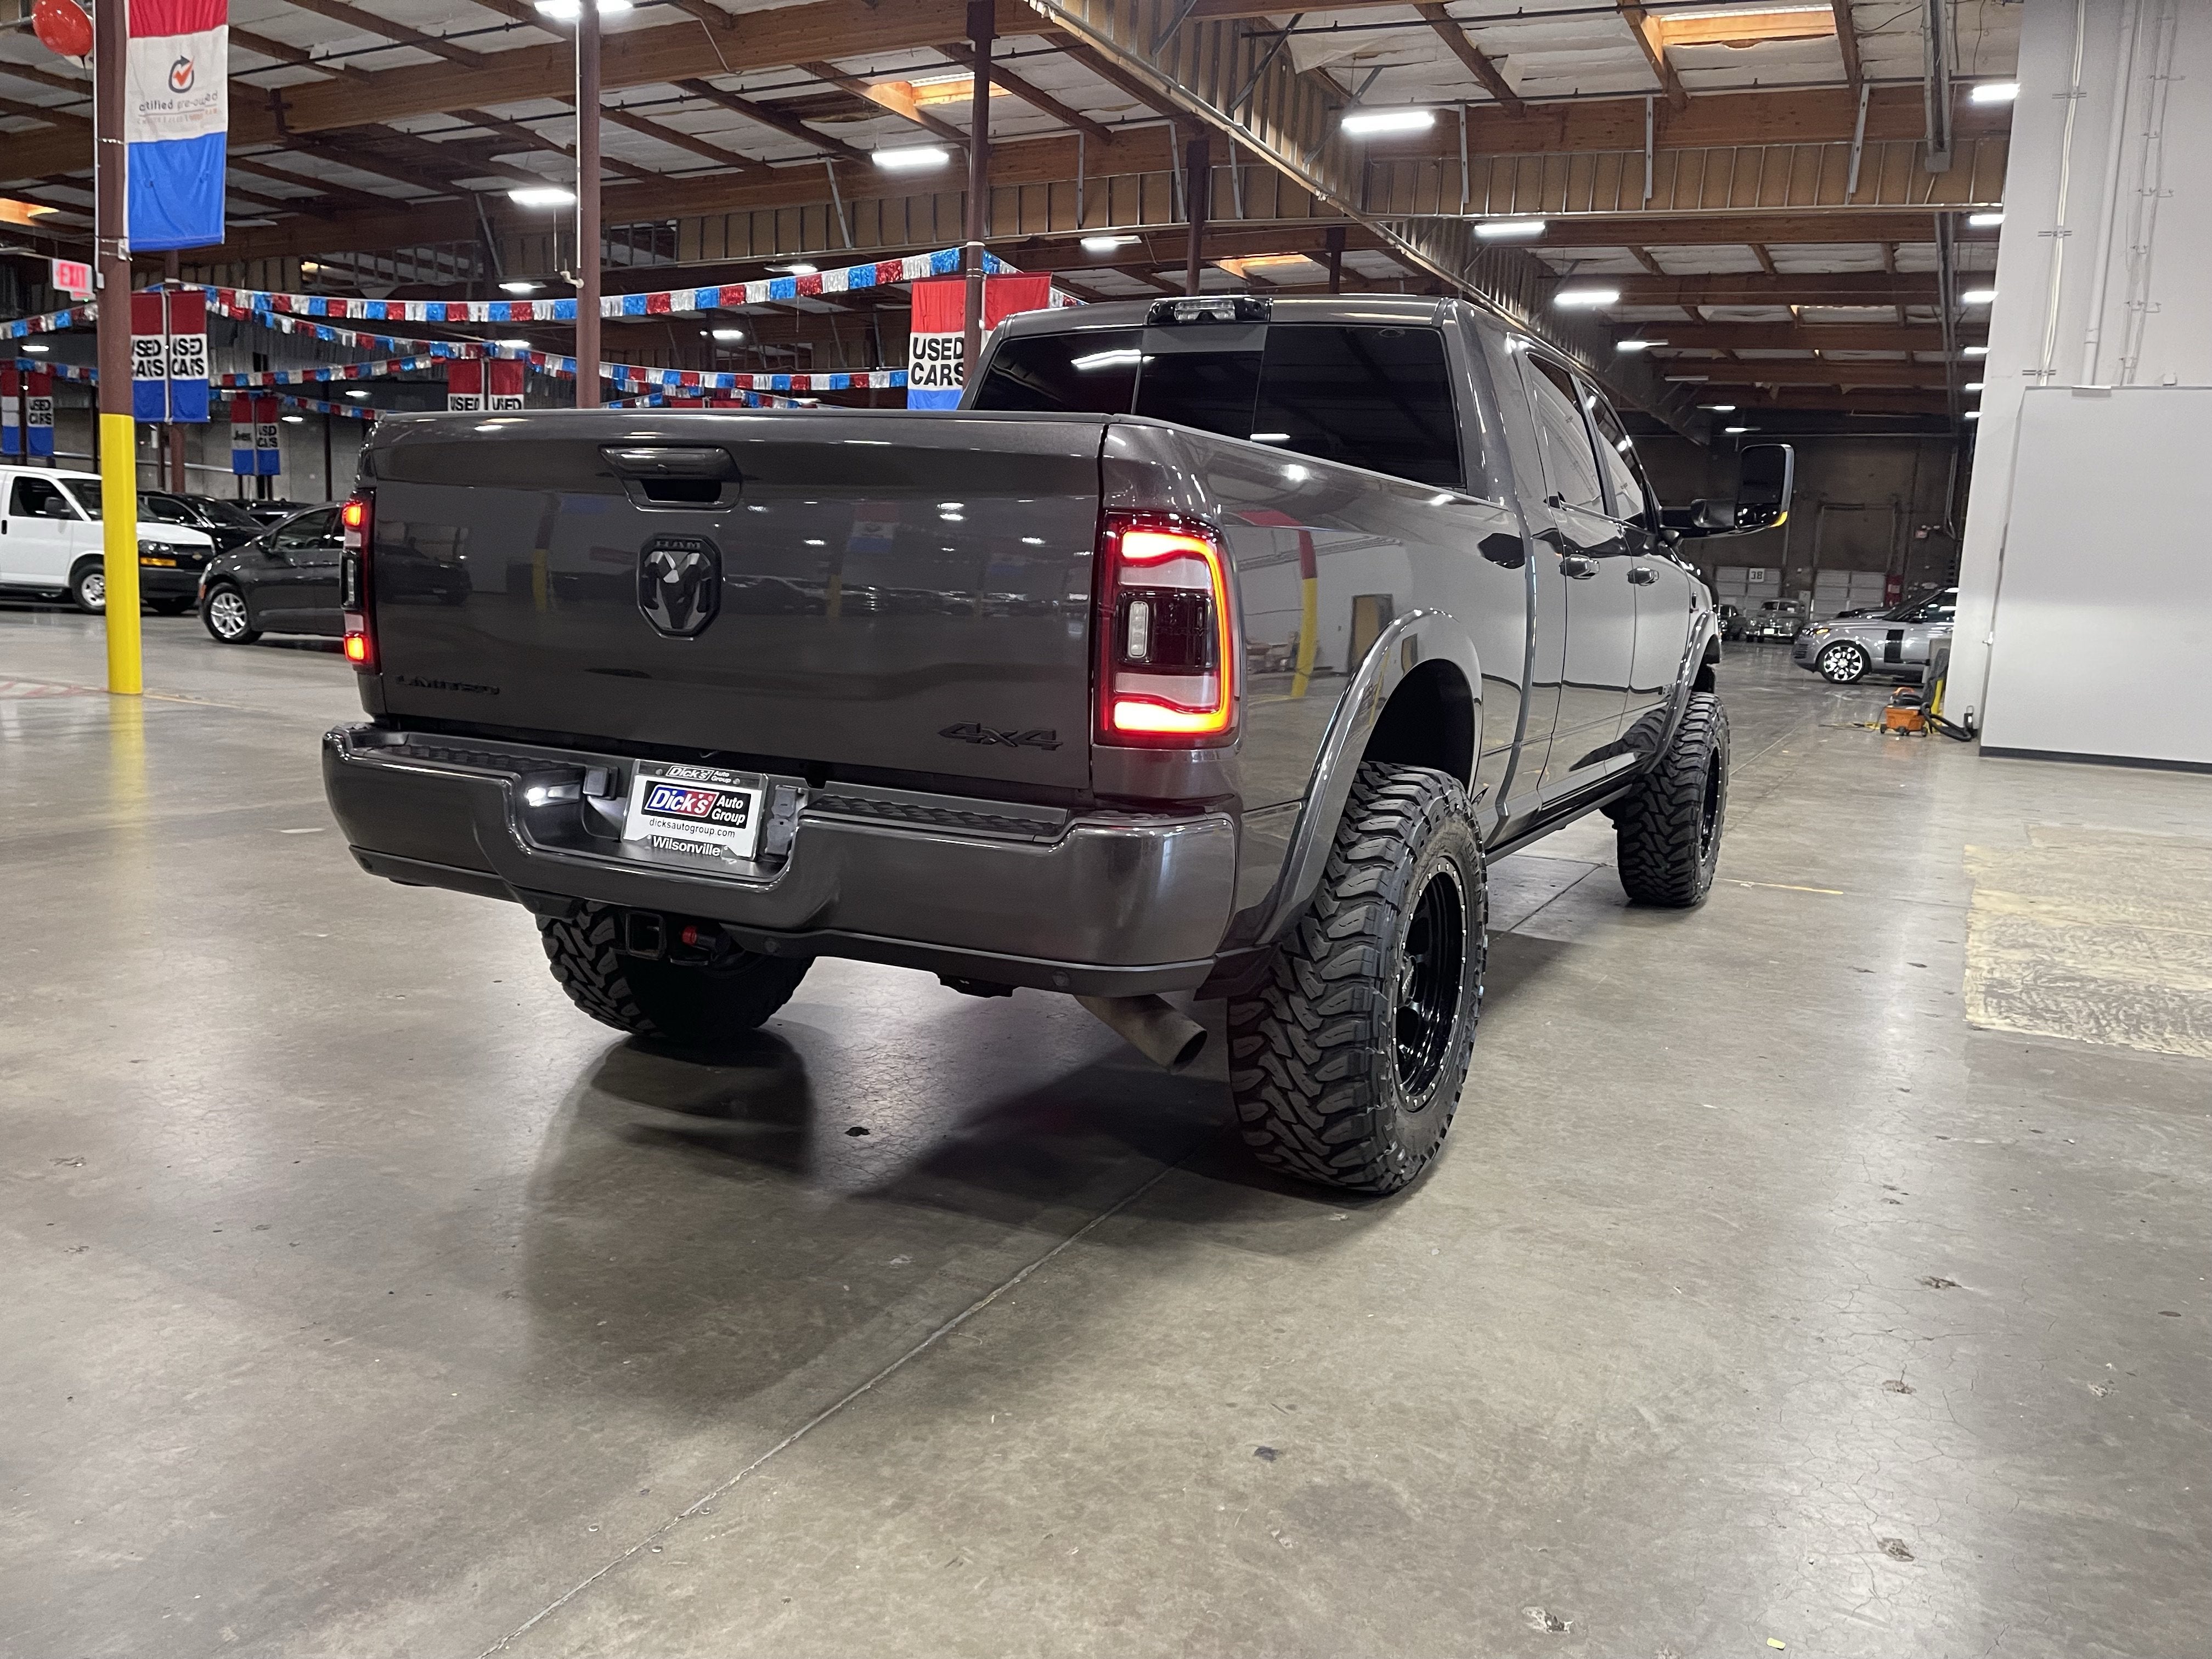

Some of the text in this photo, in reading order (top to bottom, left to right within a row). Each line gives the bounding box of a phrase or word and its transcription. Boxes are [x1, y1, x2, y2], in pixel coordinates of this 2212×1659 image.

[139, 99, 173, 111] ctified
[60, 263, 86, 289] EXIT
[913, 337, 964, 361] USED
[132, 359, 164, 377] ARS
[911, 362, 964, 386] CARS
[1751, 571, 1763, 579] 38
[669, 768, 707, 779] Dick's
[711, 775, 731, 783] Group
[651, 789, 709, 814] Dick's
[716, 795, 744, 809] Auto
[712, 808, 746, 826] Group
[649, 818, 736, 838] dicksautogroup.com
[653, 836, 721, 856] Wilsonville
